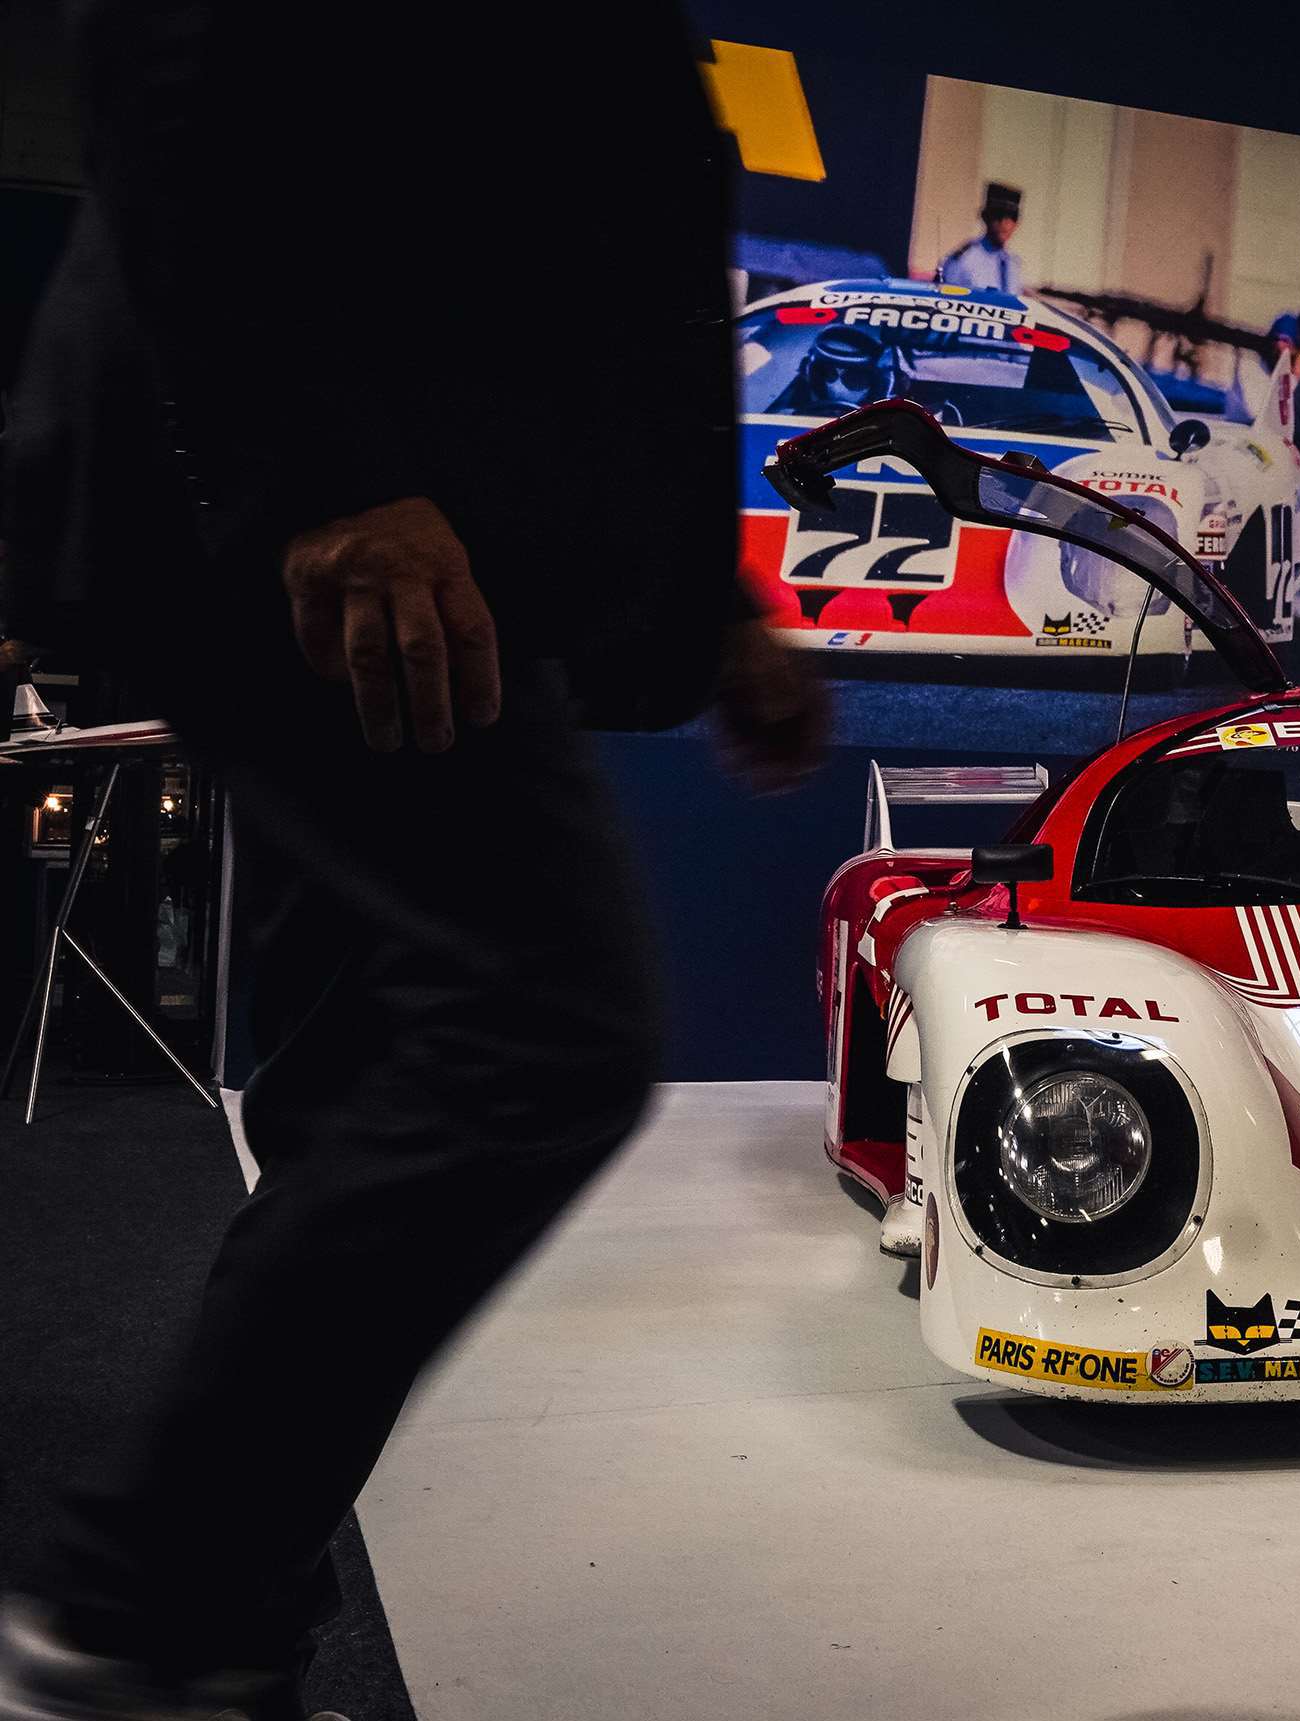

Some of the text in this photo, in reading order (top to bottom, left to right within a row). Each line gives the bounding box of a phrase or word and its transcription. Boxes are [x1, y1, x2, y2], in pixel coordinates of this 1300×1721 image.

[844, 307, 1004, 340] FACOM
[1077, 480, 1183, 508] TOTAL
[789, 488, 956, 584] 72
[974, 993, 1180, 1022] TOTAL
[980, 1335, 1036, 1371] PARIS
